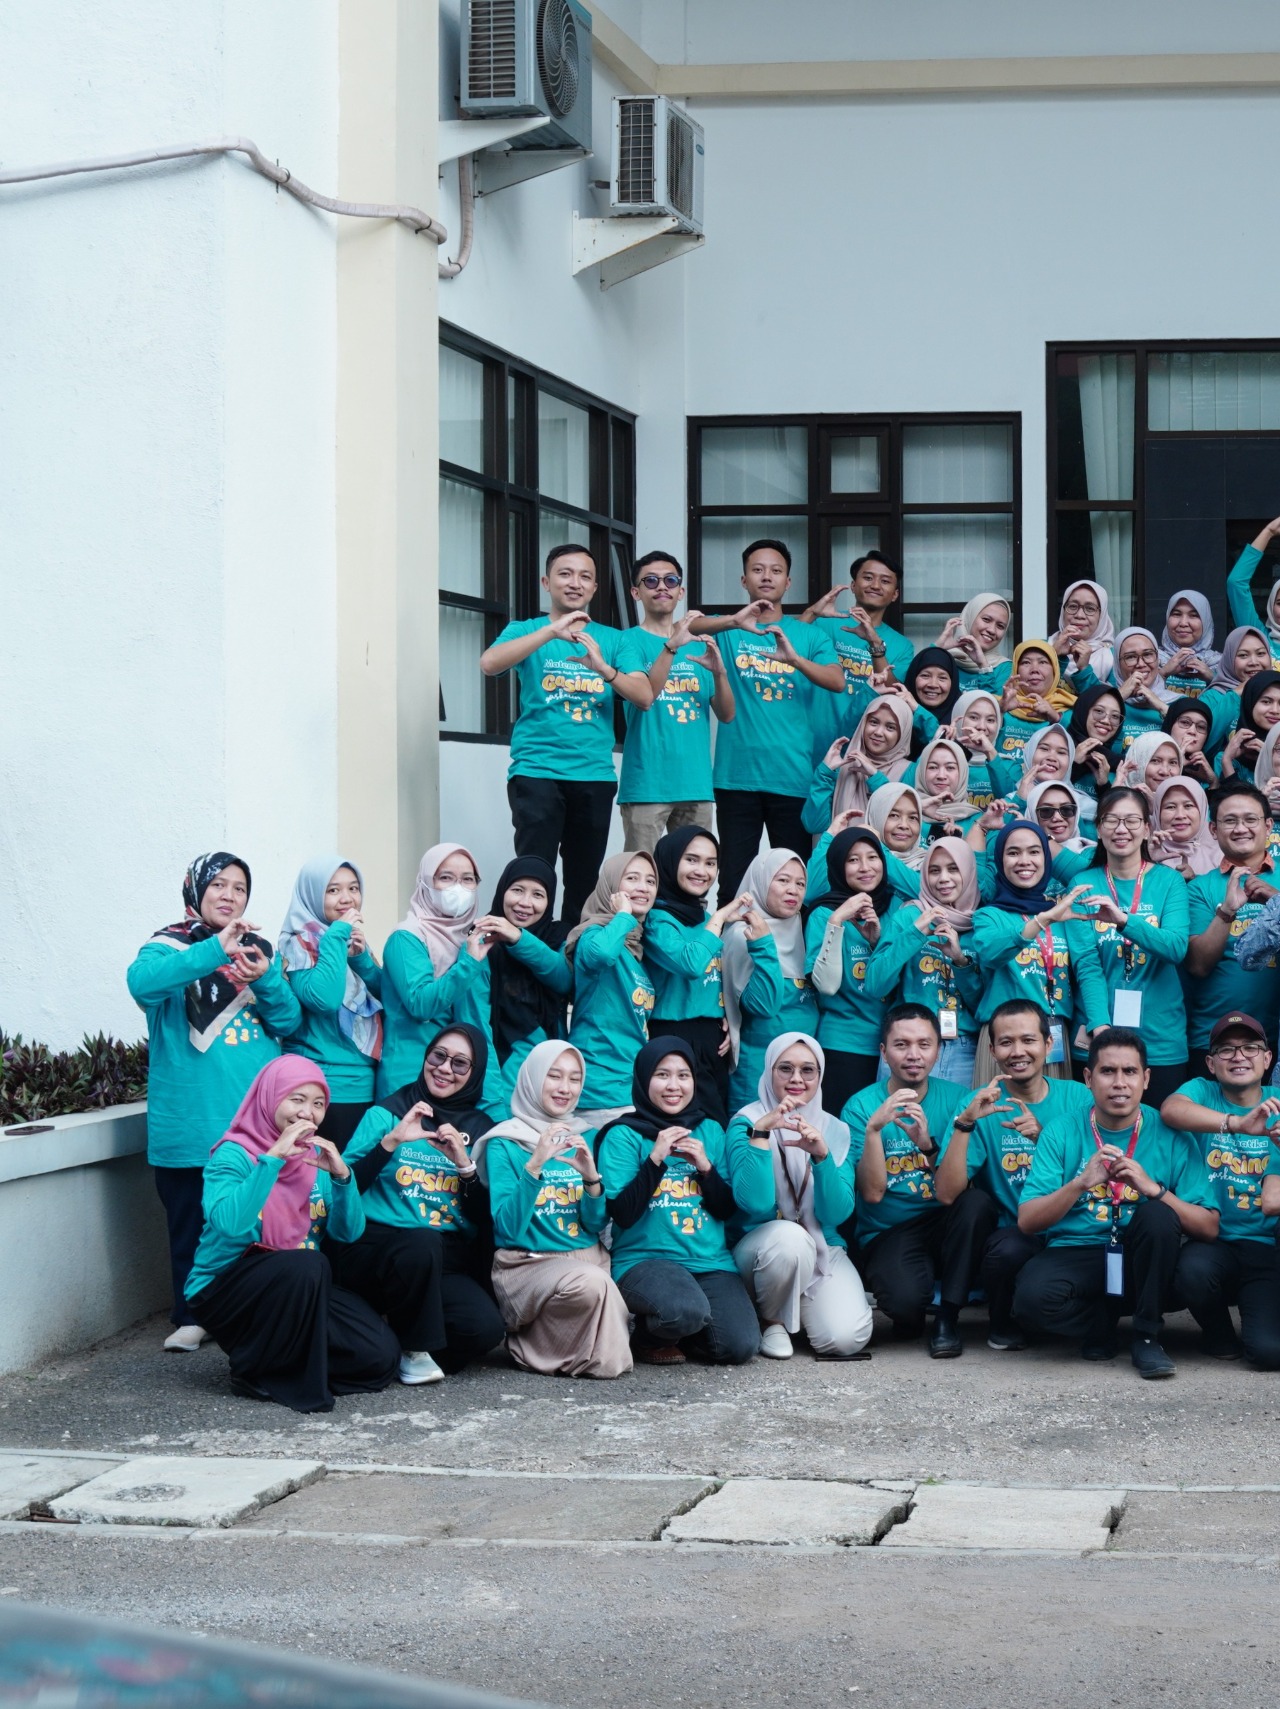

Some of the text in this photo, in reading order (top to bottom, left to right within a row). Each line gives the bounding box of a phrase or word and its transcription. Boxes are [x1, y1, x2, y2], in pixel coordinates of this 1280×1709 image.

[225, 1027, 250, 1045] 2 3
[920, 1182, 933, 1199] 2
[1237, 1193, 1250, 1209] 2
[429, 1210, 442, 1226] 2
[1096, 1205, 1108, 1222] 2
[567, 1222, 579, 1237] 2
[681, 1217, 695, 1234] 2
